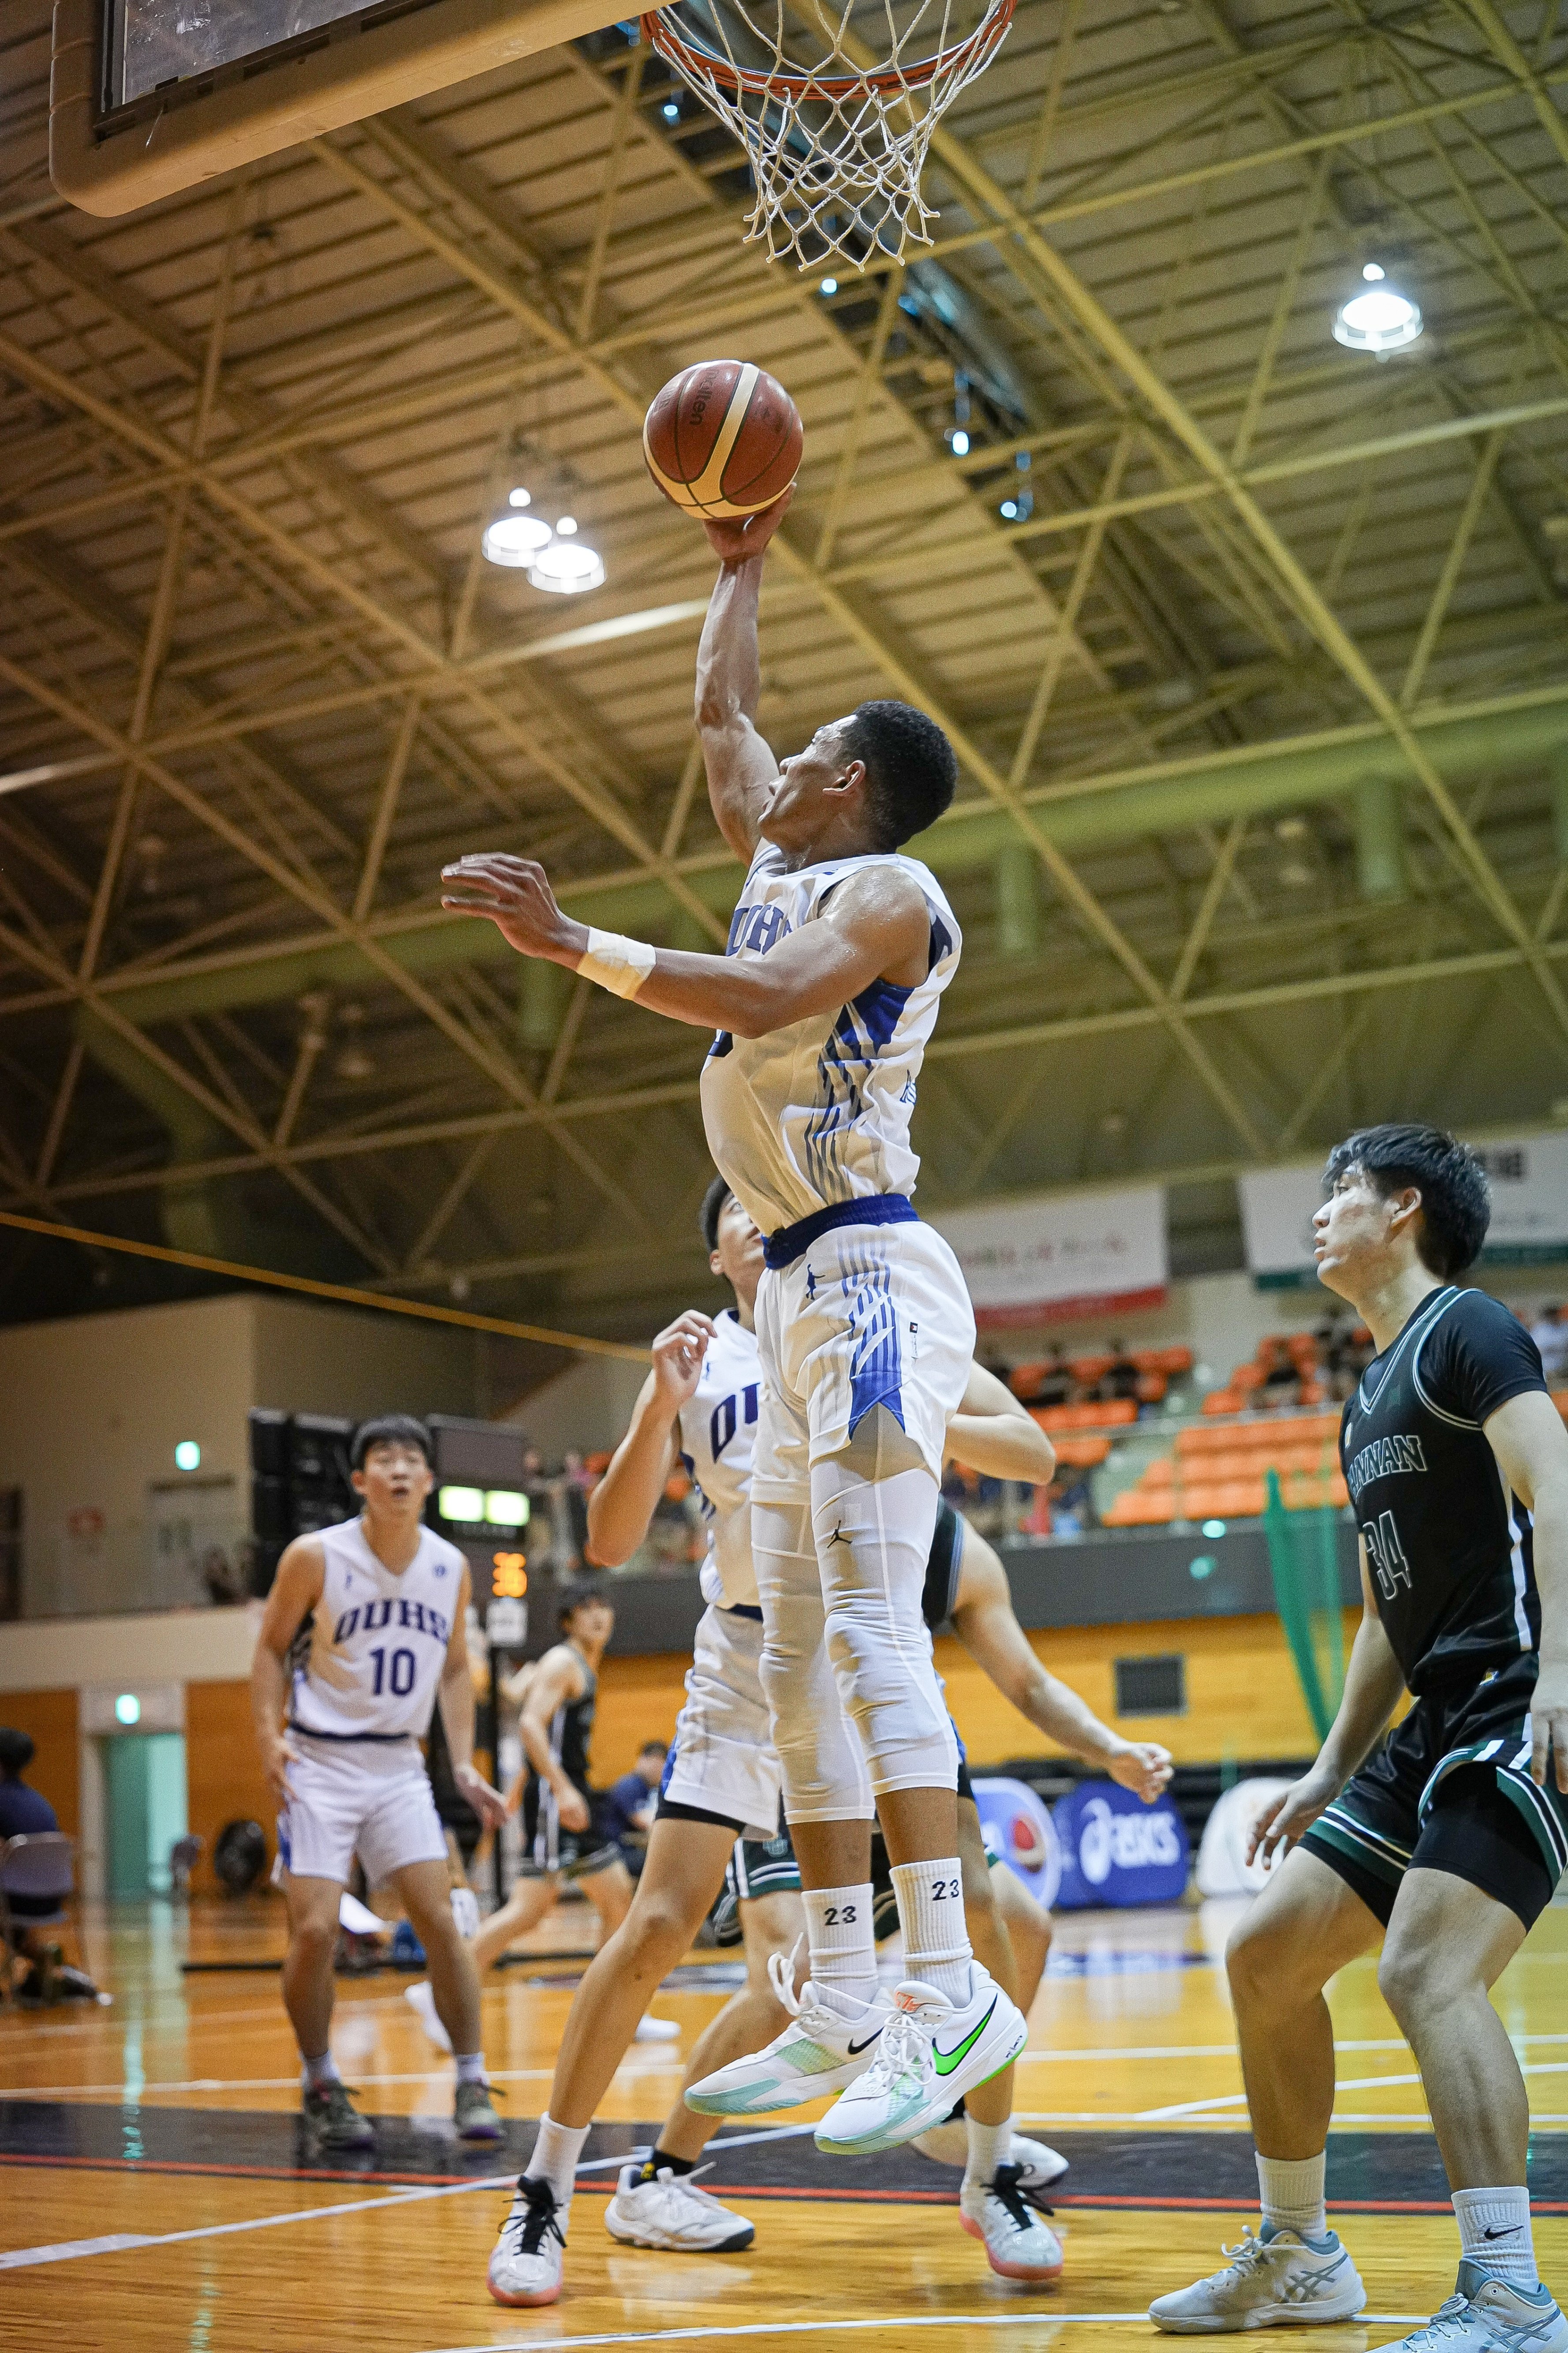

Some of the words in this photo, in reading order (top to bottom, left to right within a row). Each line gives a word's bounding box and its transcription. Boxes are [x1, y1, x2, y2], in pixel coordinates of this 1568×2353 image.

[1363, 1510, 1412, 1600] 34
[370, 1647, 416, 1697] 10
[932, 1878, 959, 1901] 23
[825, 1905, 856, 1926] 23
